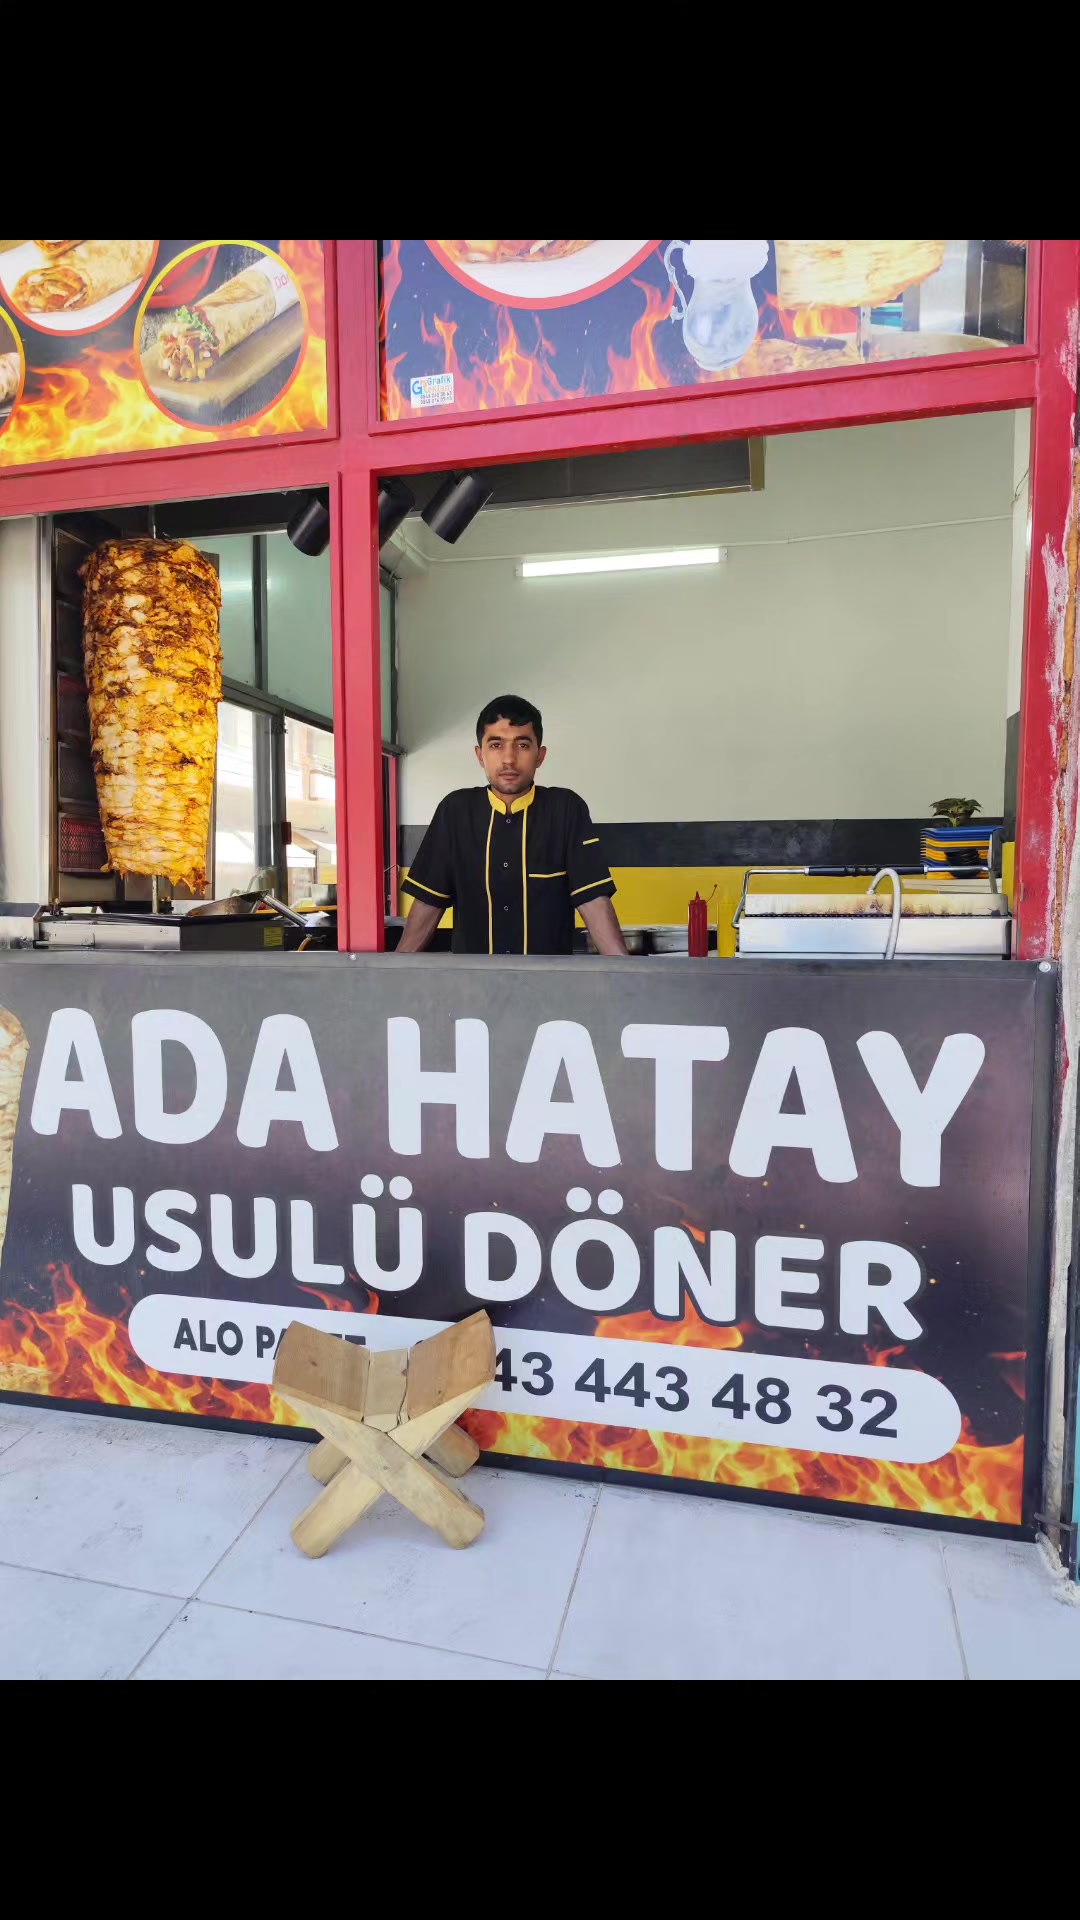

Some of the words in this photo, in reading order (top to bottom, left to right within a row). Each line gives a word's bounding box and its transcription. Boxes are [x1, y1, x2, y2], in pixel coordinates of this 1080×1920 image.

[427, 375, 451, 386] Grafik
[30, 1007, 339, 1152] ADA
[386, 1016, 986, 1188] HATAY
[71, 1173, 424, 1292] USULÜ
[464, 1186, 923, 1341] DÖNER
[173, 1317, 244, 1356] ALO
[574, 1357, 690, 1412] 443
[711, 1373, 792, 1425] 48
[816, 1384, 898, 1439] 32
